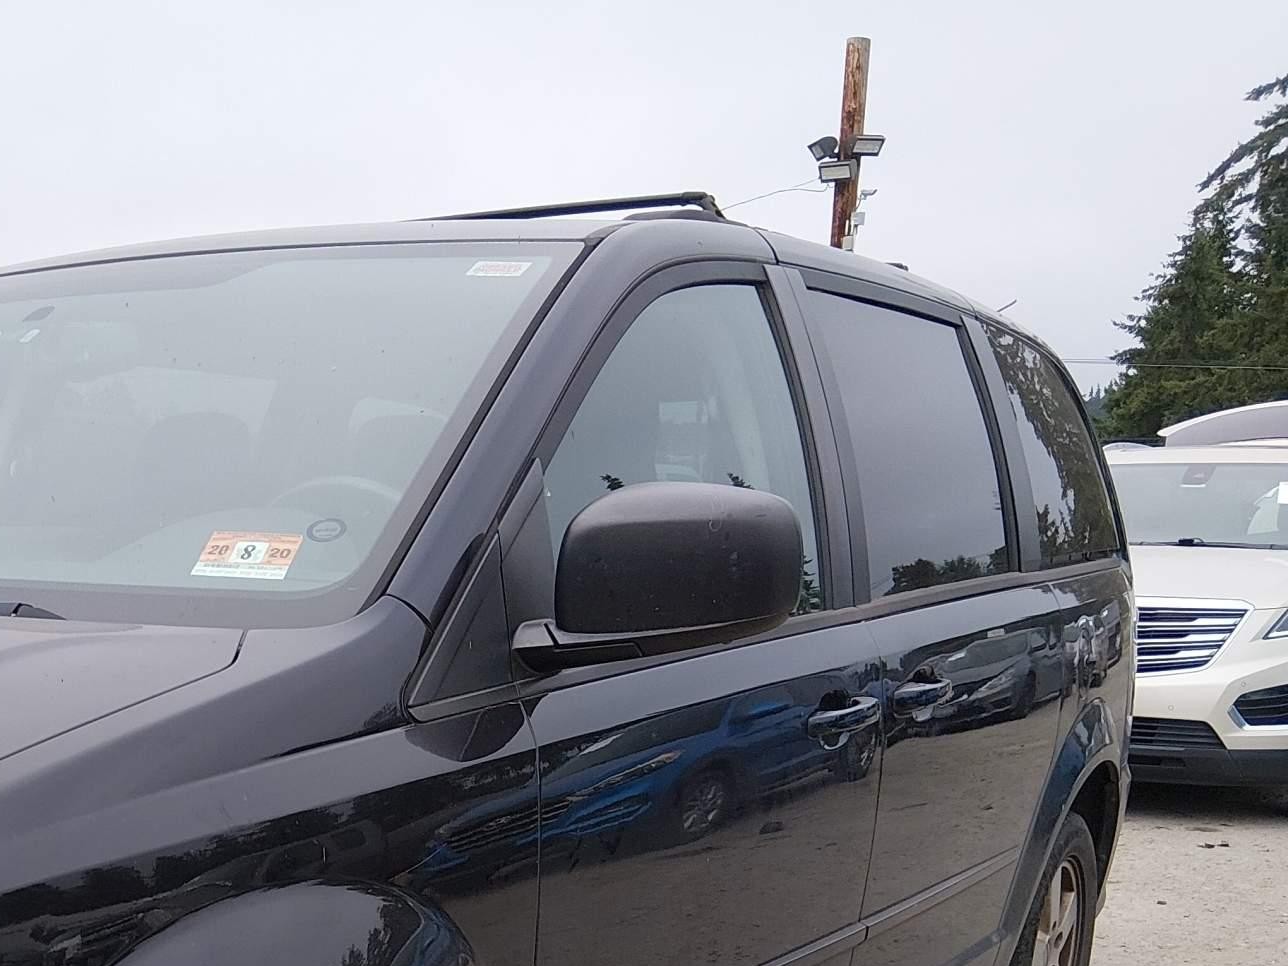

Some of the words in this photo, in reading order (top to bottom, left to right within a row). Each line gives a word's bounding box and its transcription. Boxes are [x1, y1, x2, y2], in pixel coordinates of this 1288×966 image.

[207, 544, 230, 556] 20
[240, 544, 256, 561] 8
[268, 547, 291, 559] 20
